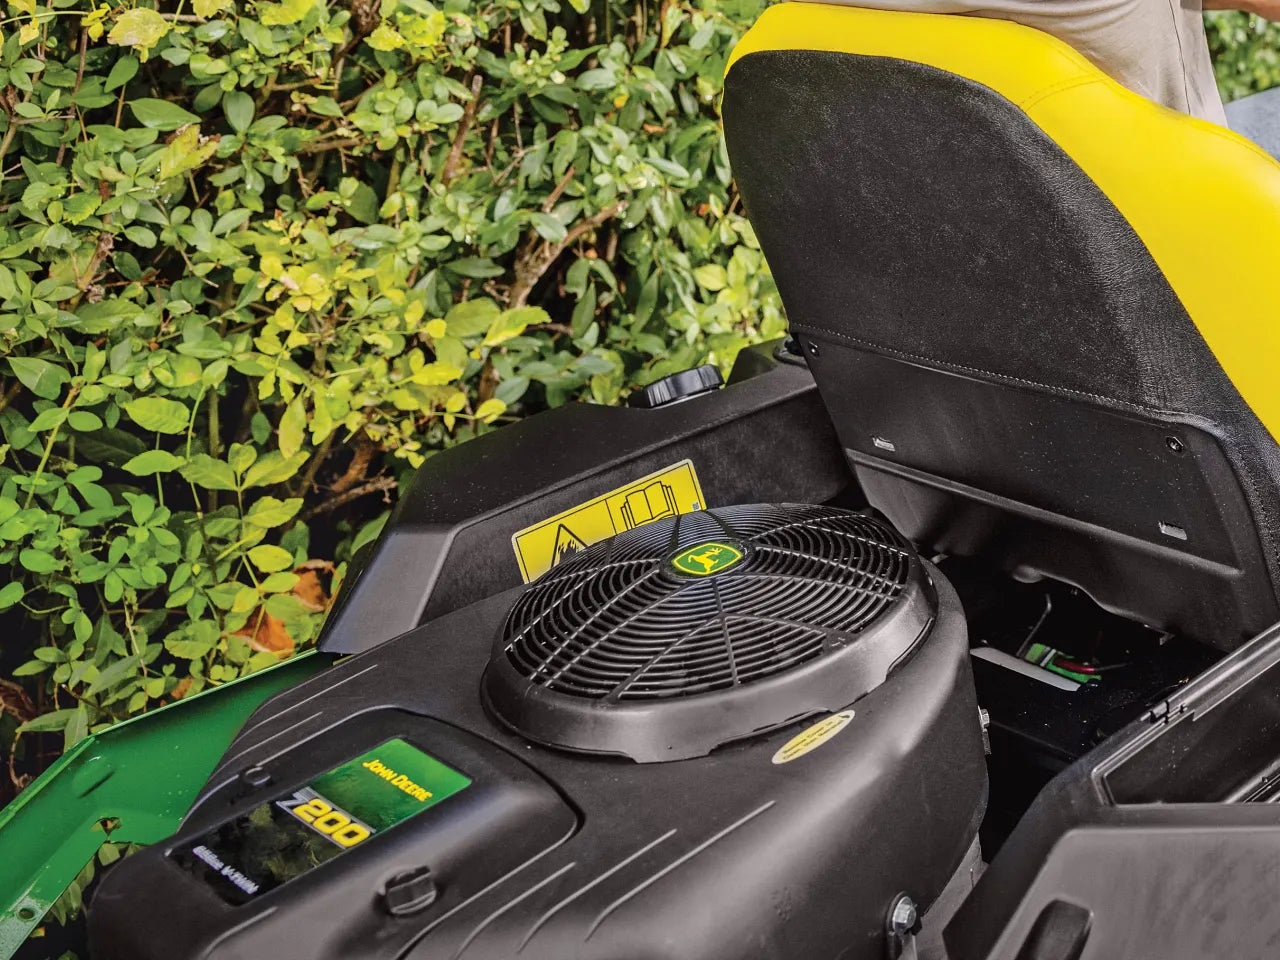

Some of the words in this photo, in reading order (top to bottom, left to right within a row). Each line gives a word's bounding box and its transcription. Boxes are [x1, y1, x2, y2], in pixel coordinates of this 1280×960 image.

[362, 759, 398, 781] JOHN
[391, 774, 434, 802] DEERE
[275, 786, 373, 848] Z200
